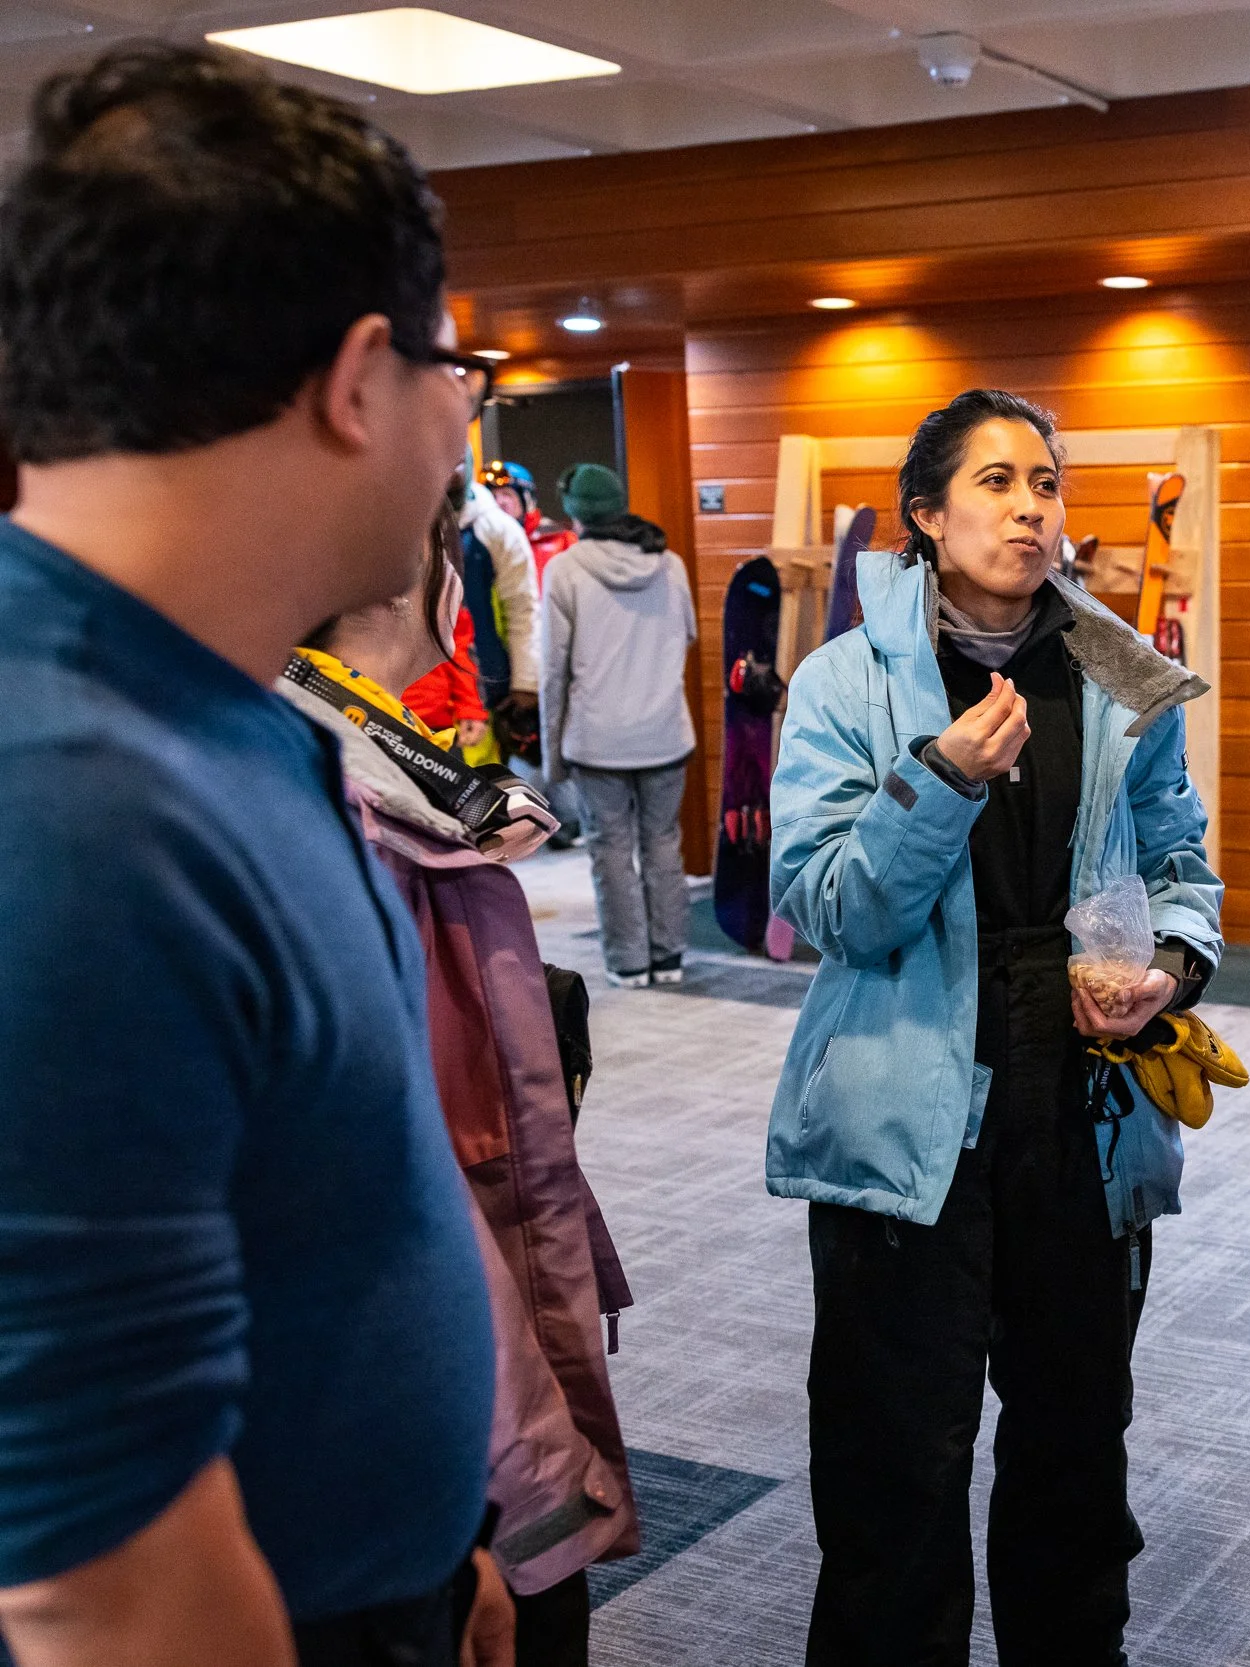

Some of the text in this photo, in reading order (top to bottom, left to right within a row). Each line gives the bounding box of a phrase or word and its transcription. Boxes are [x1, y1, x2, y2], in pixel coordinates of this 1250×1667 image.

[367, 721, 403, 742] PUT YOUR
[412, 753, 458, 782] DOWN
